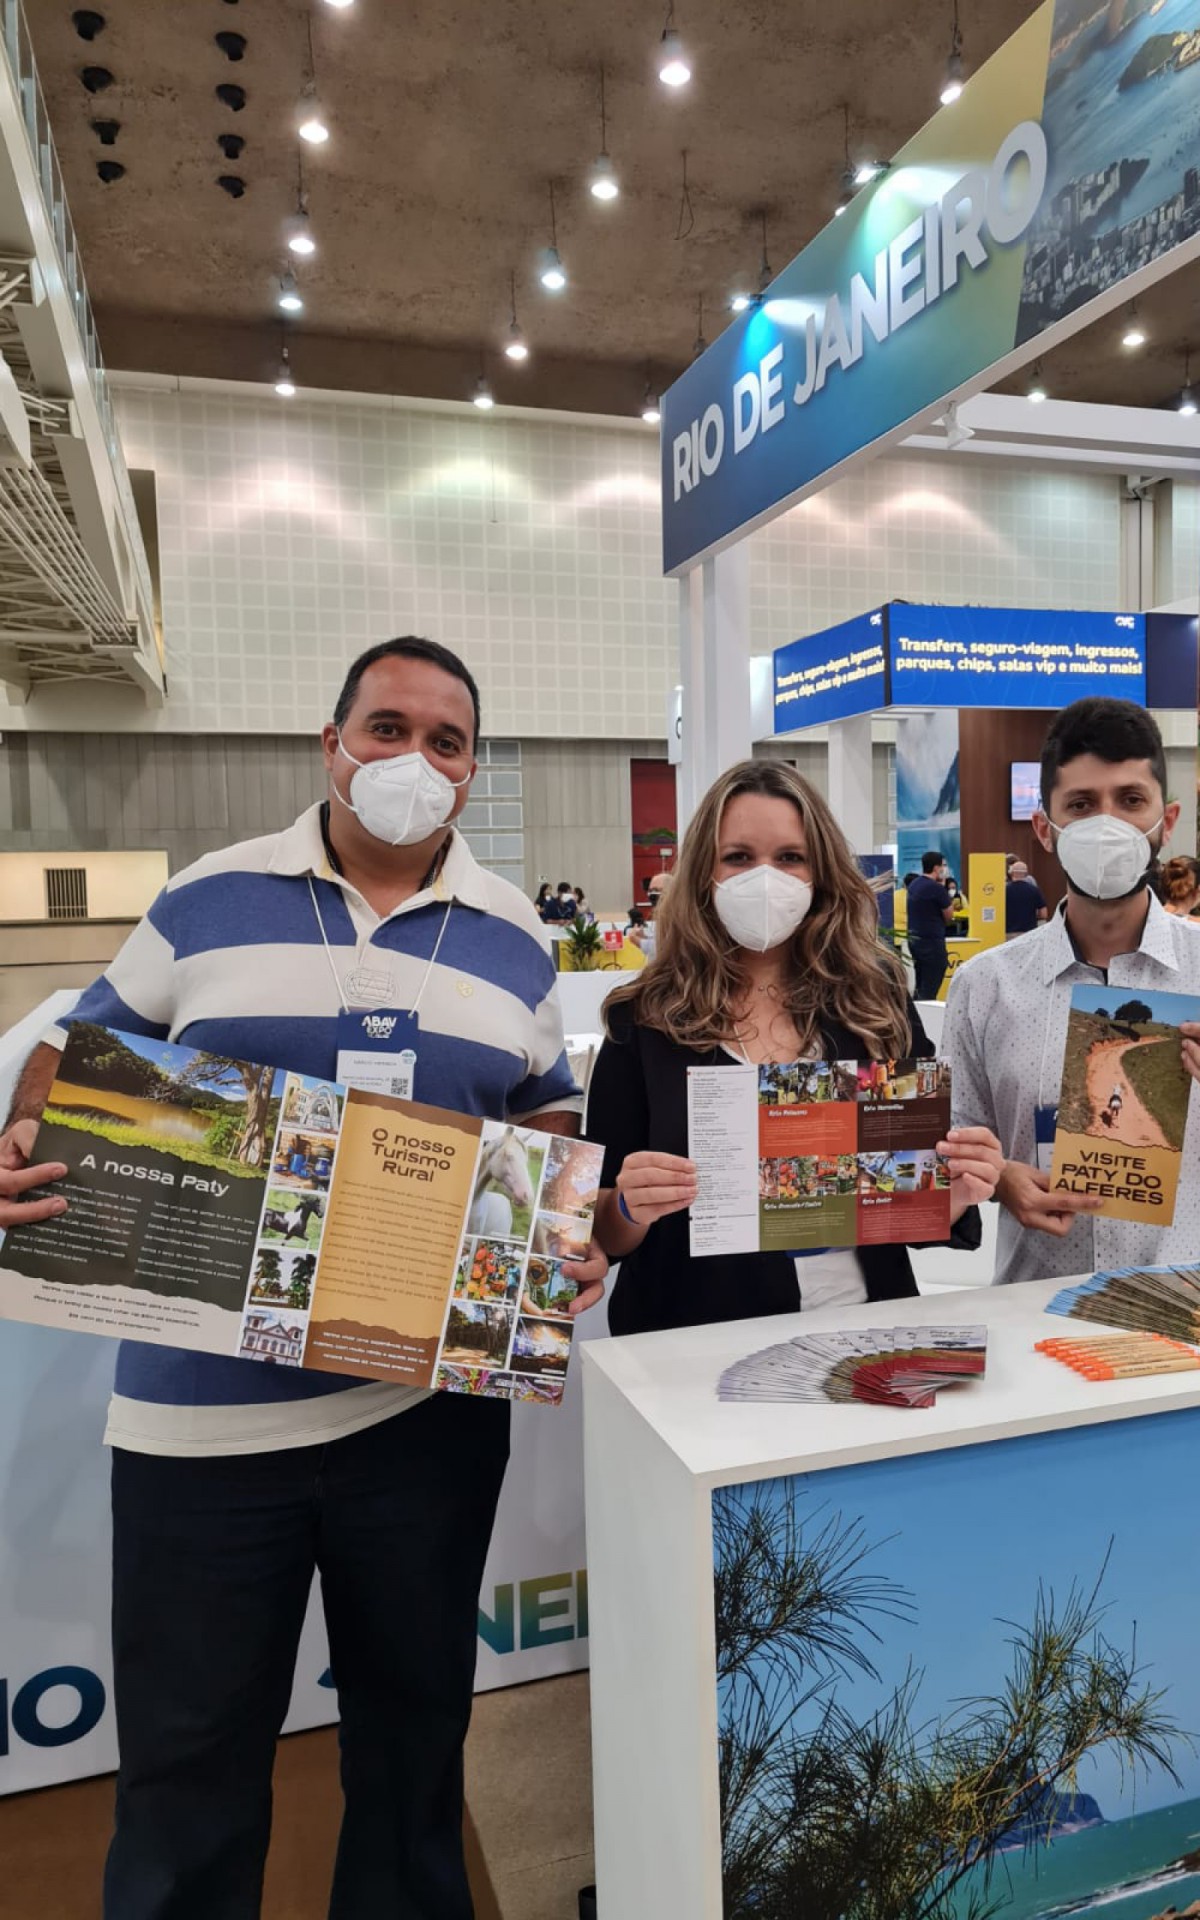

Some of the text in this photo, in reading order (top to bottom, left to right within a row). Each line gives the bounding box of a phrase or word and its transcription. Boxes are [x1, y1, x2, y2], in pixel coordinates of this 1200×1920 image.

[673, 120, 1048, 502] RIO DE JANEIRO
[898, 637, 1139, 660] Transfers, seguro-viagem, ingressos,
[896, 657, 1143, 675] parques, chips, salas vip e muito mais!
[361, 1015, 397, 1027] ABAV
[366, 1026, 392, 1035] EXPO
[372, 1128, 455, 1156] O nosso
[372, 1142, 450, 1170] Turismo
[1080, 1150, 1147, 1170] VISITE
[80, 1154, 229, 1197] A nossa Paty
[382, 1160, 434, 1182] Rural
[1062, 1163, 1161, 1189] PATY DO
[1055, 1178, 1163, 1205] ALFERES
